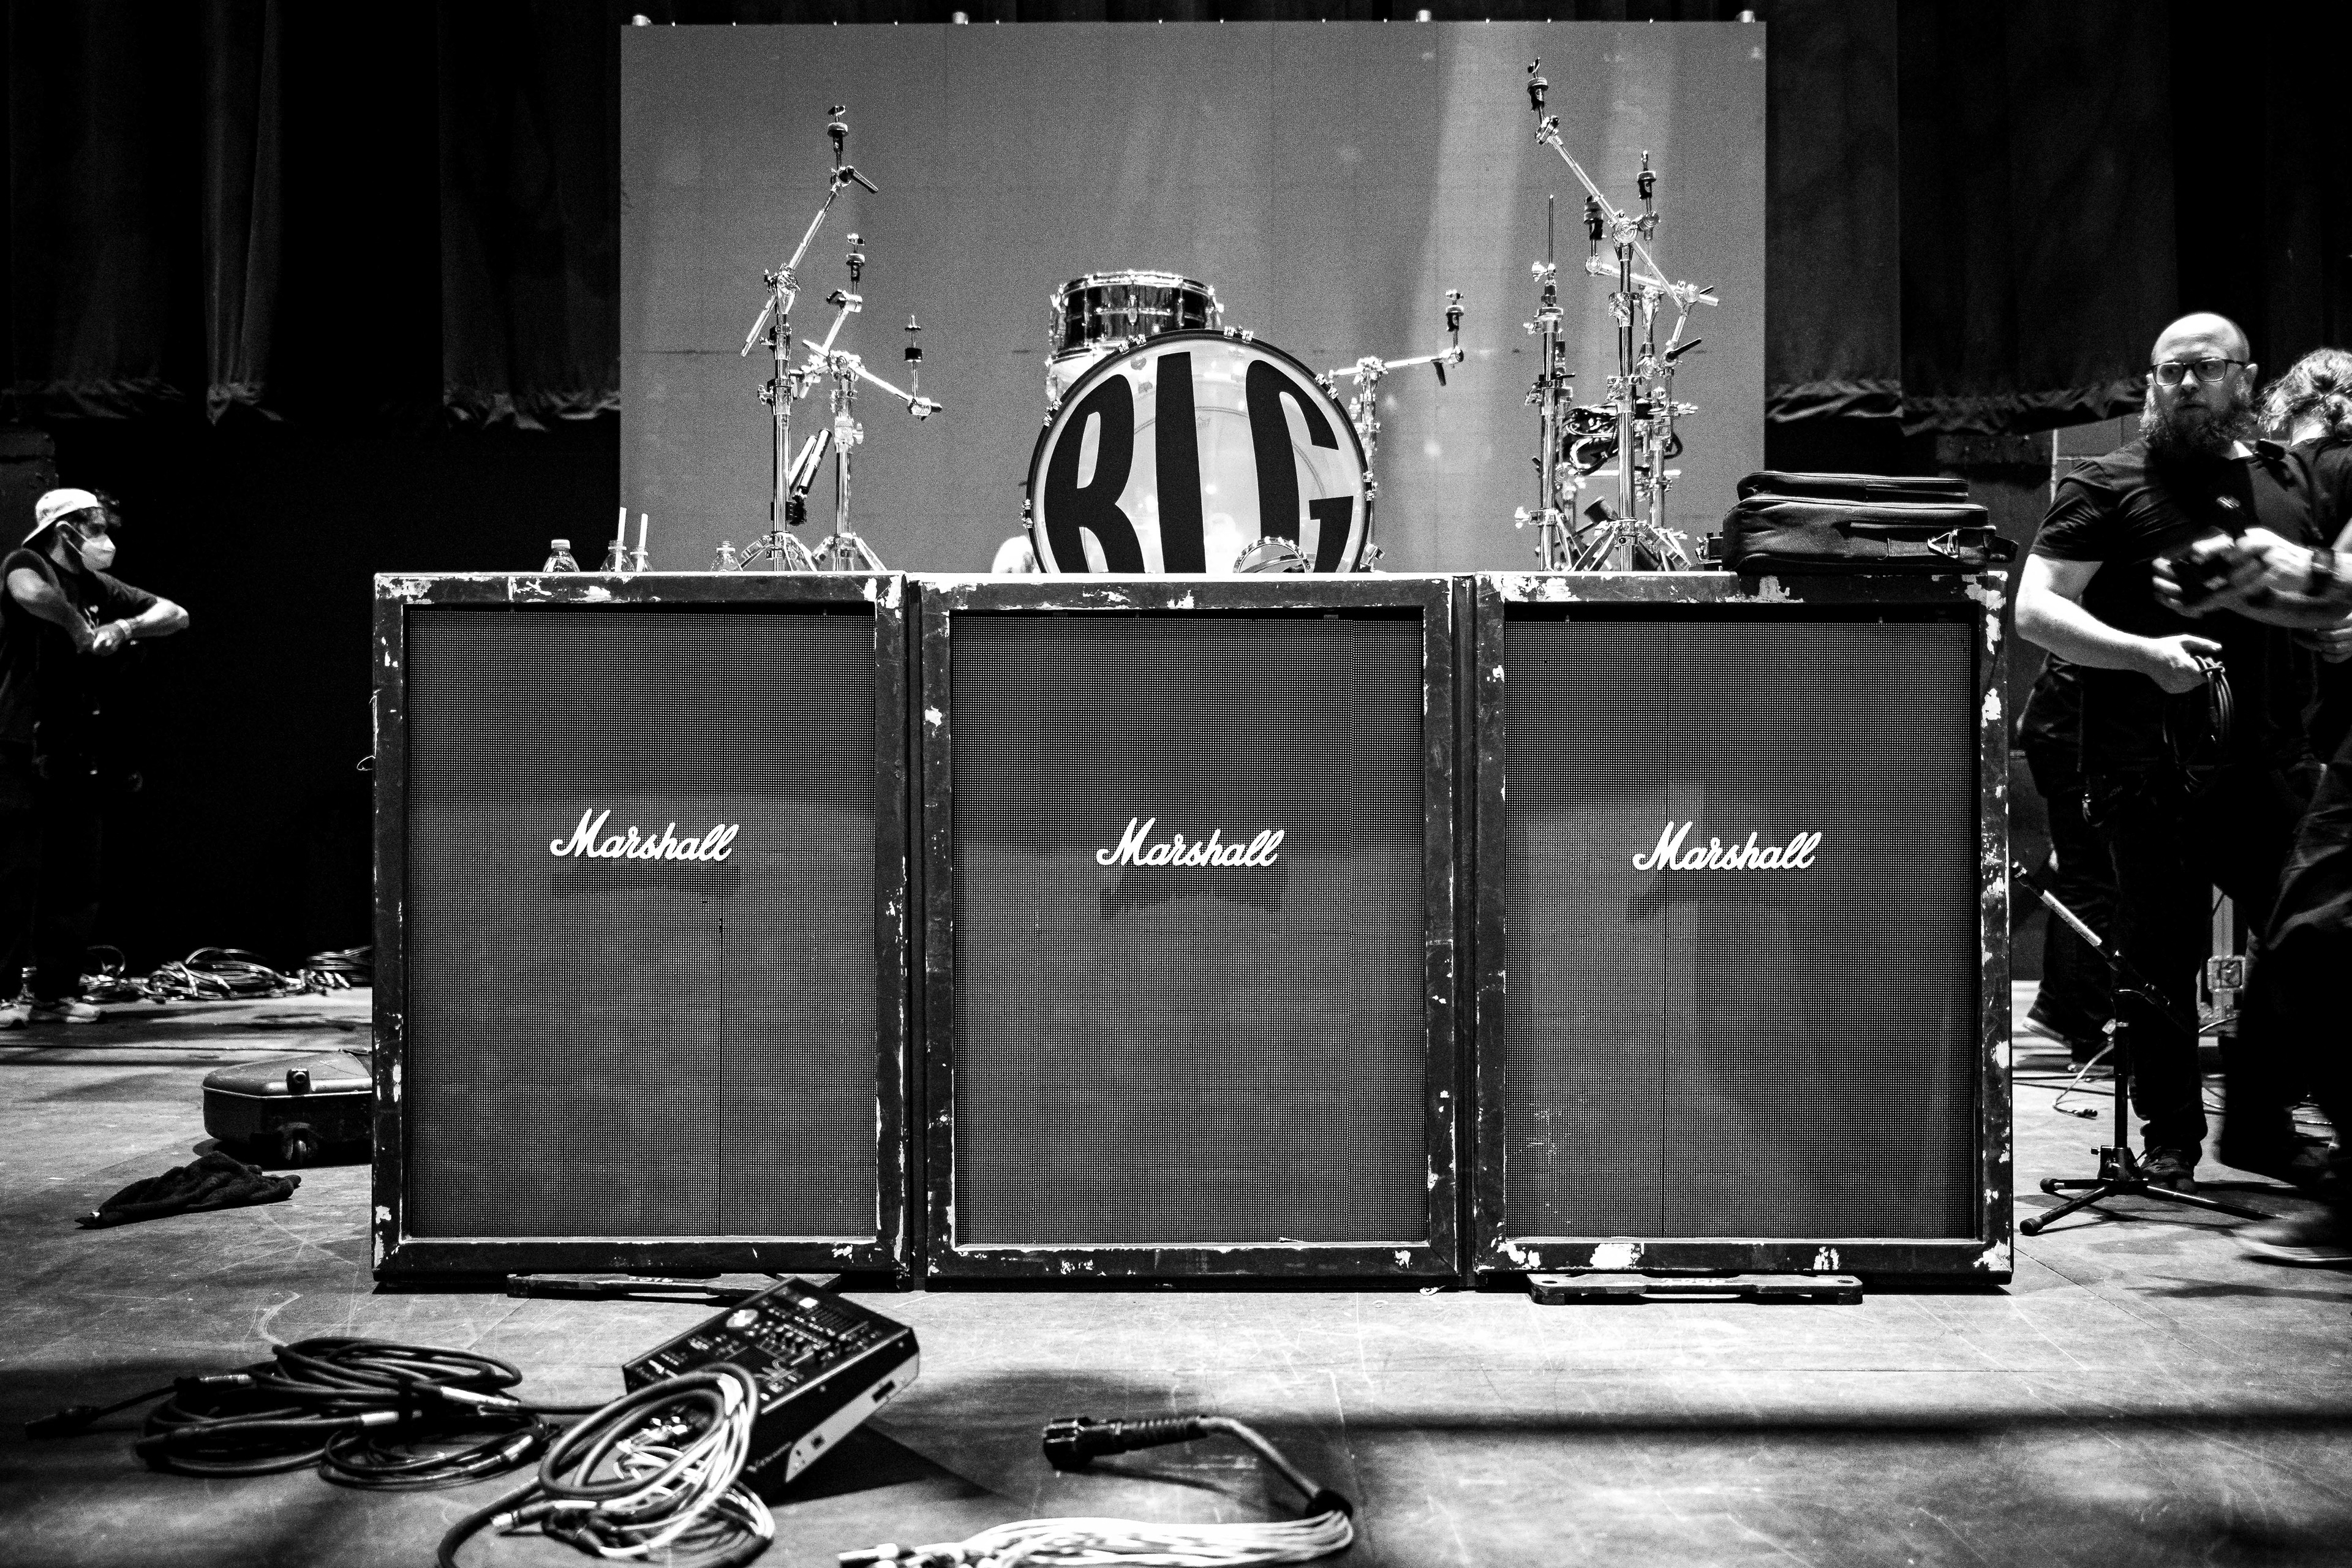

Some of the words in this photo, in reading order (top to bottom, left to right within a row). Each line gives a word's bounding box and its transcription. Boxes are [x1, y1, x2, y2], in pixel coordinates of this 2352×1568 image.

[549, 808, 740, 862] Marshall
[1096, 817, 1285, 866] Marshall
[1632, 821, 1822, 870] Marshall
